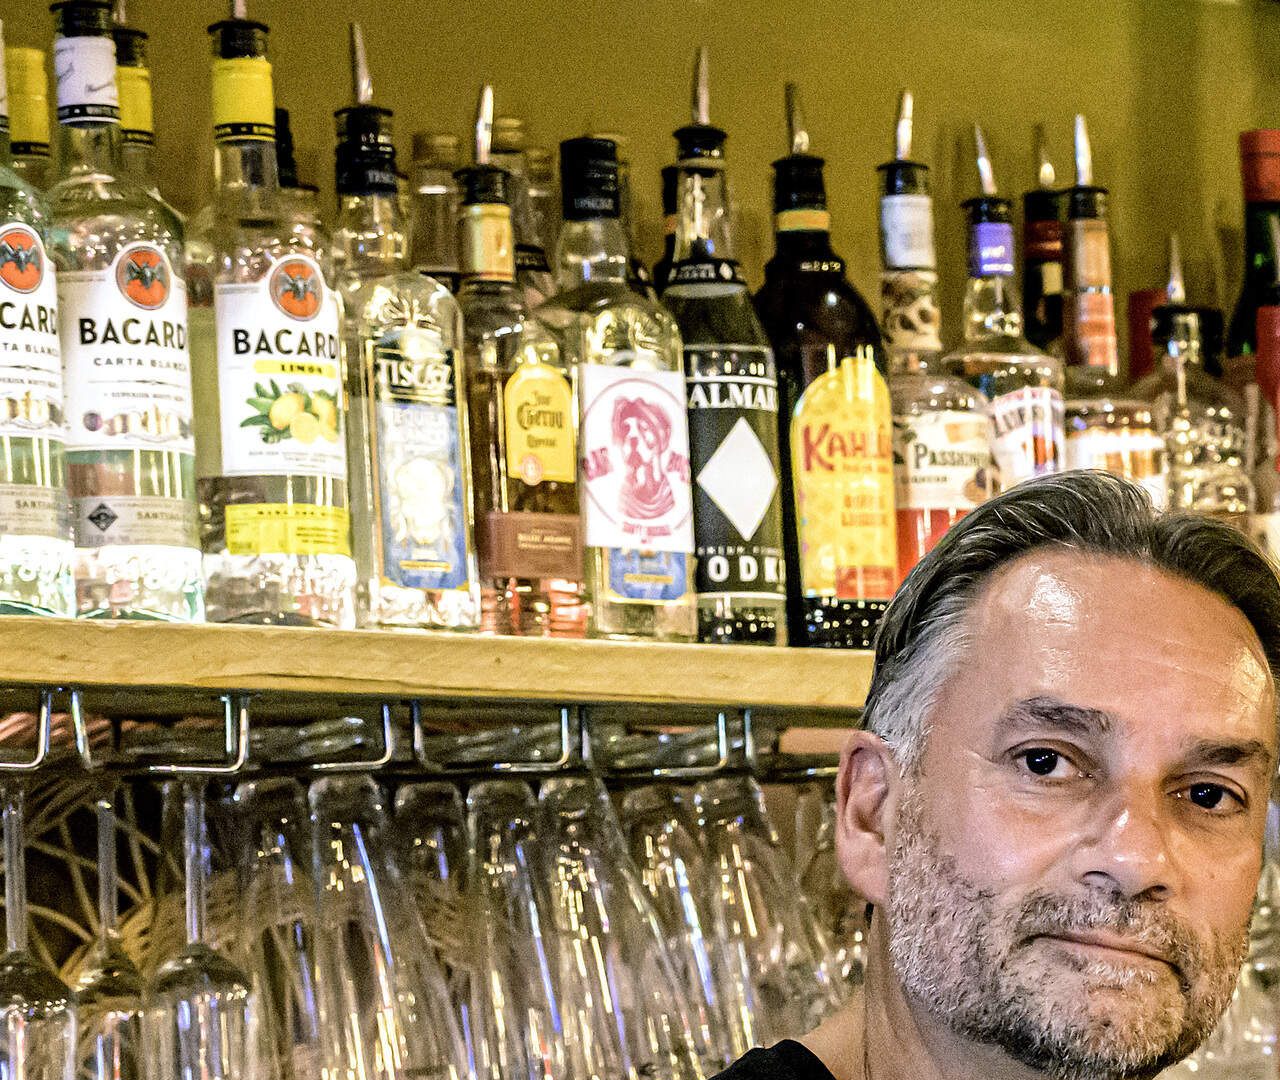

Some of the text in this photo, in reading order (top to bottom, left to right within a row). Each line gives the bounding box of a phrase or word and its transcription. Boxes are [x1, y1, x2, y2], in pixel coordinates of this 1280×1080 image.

[0, 301, 57, 336] CARD
[78, 317, 187, 351] BACARD
[234, 328, 337, 360] BACARD
[93, 357, 145, 368] CARTA
